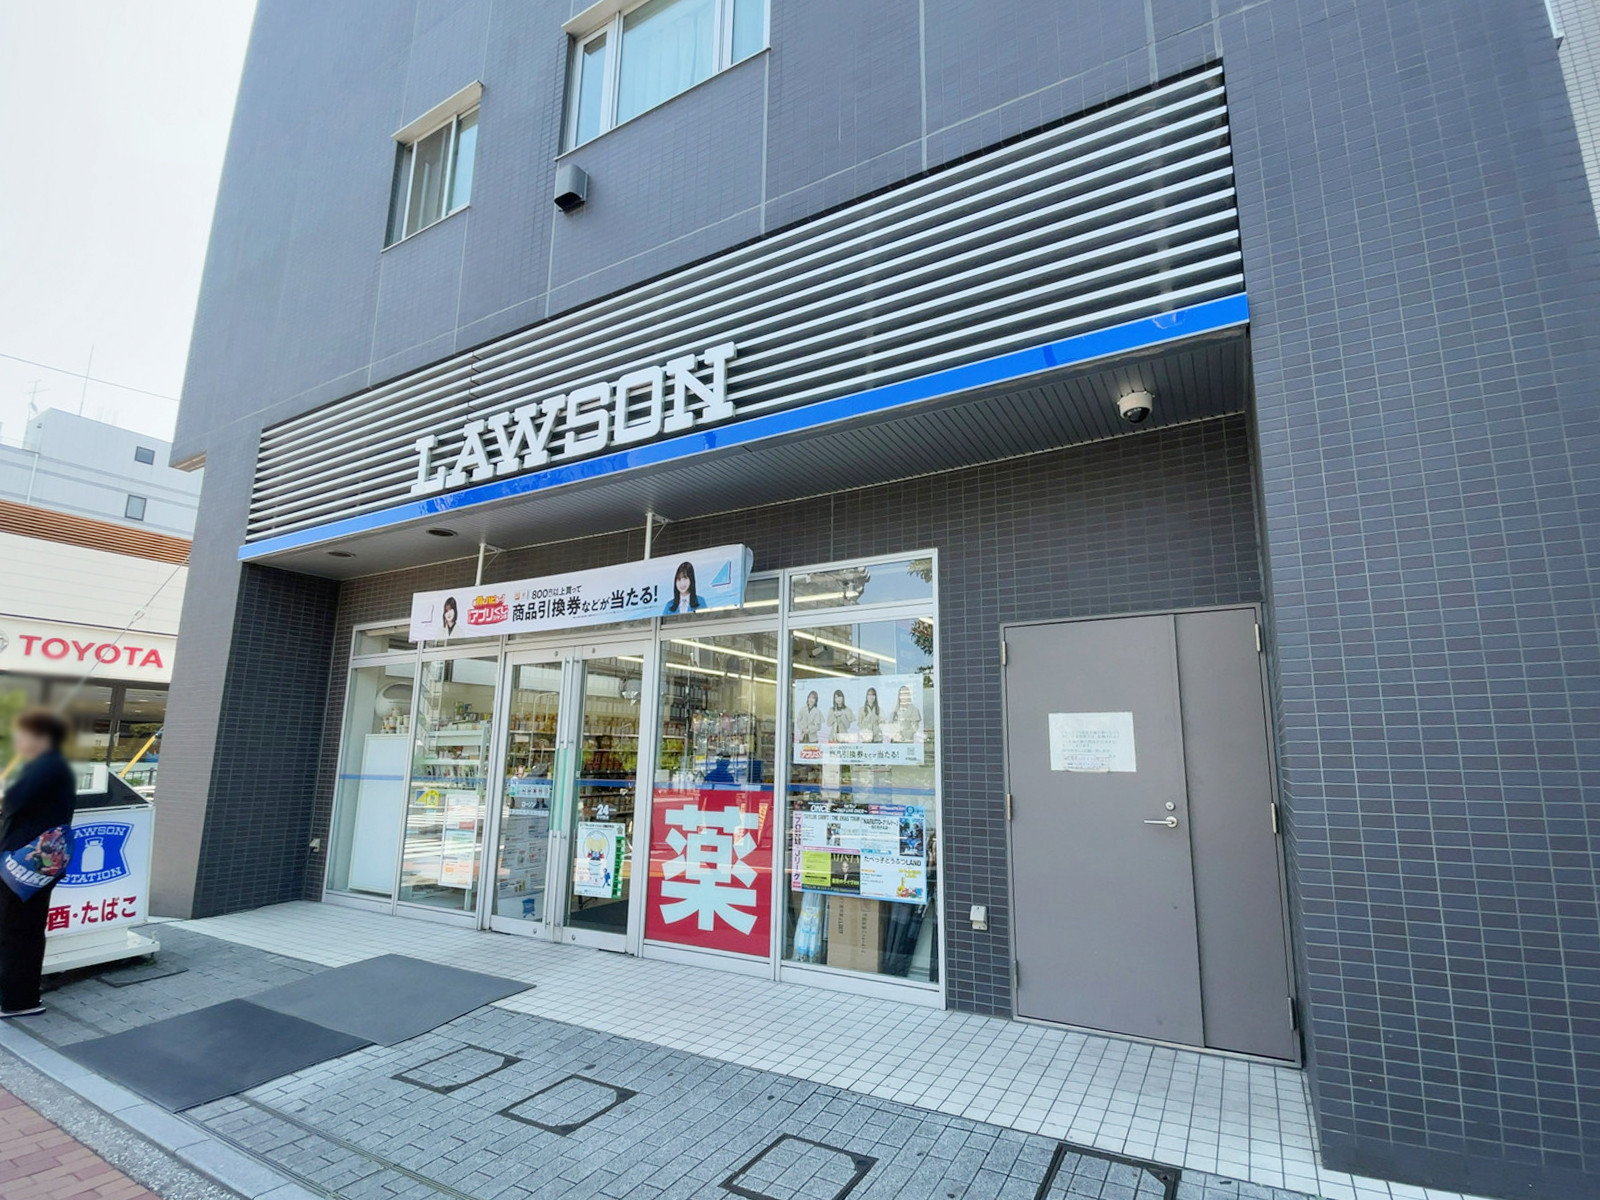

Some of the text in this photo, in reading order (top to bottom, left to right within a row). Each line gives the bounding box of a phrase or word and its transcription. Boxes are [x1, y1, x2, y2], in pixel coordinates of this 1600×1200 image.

[409, 341, 738, 496] LAWSON
[19, 634, 164, 669] TOYOTA
[597, 804, 610, 815] 24
[73, 826, 127, 839] AWSON
[60, 867, 123, 884] STATION
[659, 804, 759, 935] 薬
